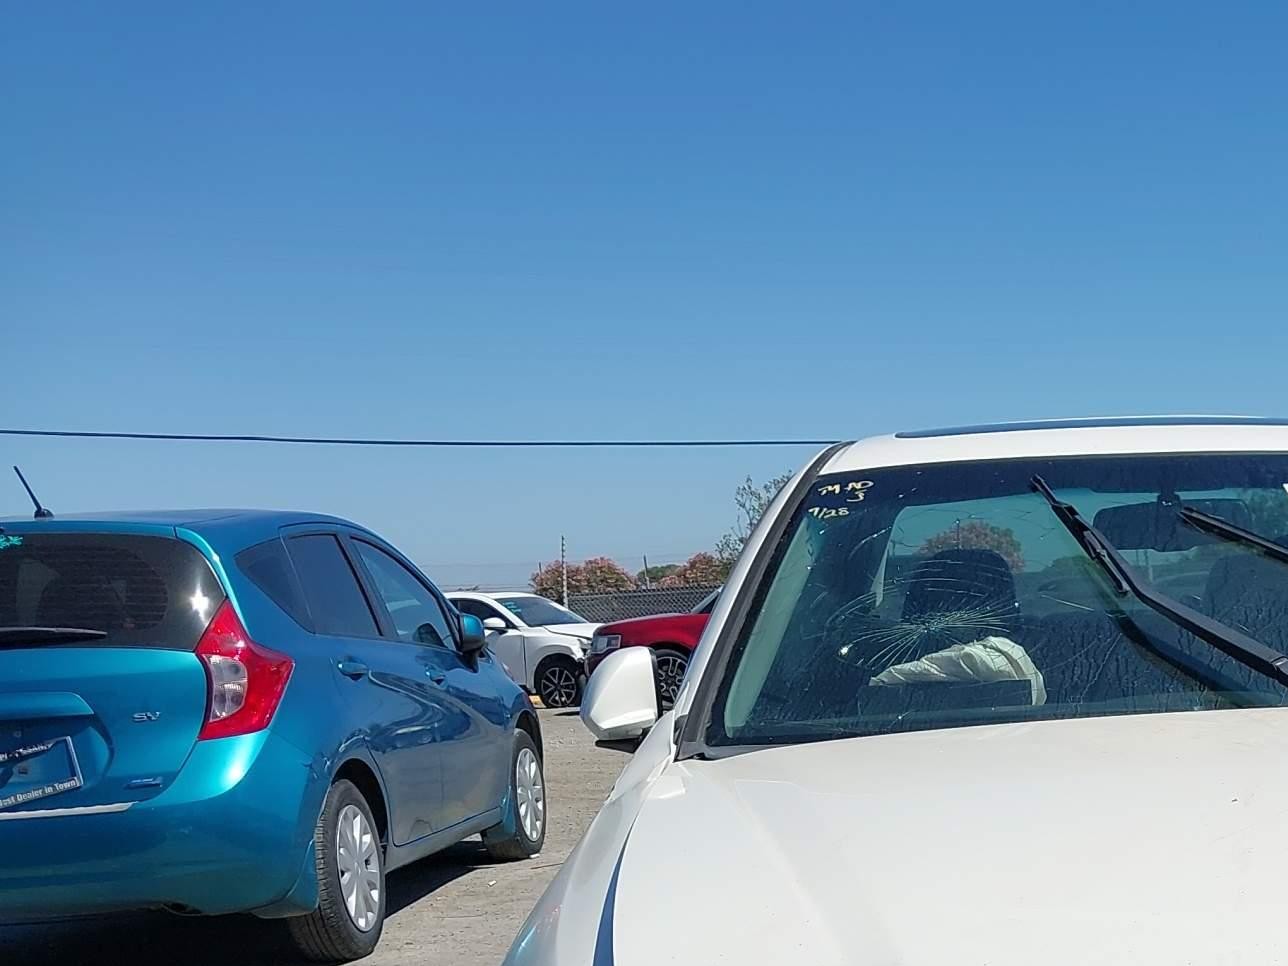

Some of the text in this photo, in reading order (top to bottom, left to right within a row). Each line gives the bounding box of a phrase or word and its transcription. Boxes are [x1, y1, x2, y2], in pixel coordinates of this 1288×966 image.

[132, 711, 162, 722] SV
[16, 788, 43, 801] Dealer
[54, 779, 76, 791] Town
